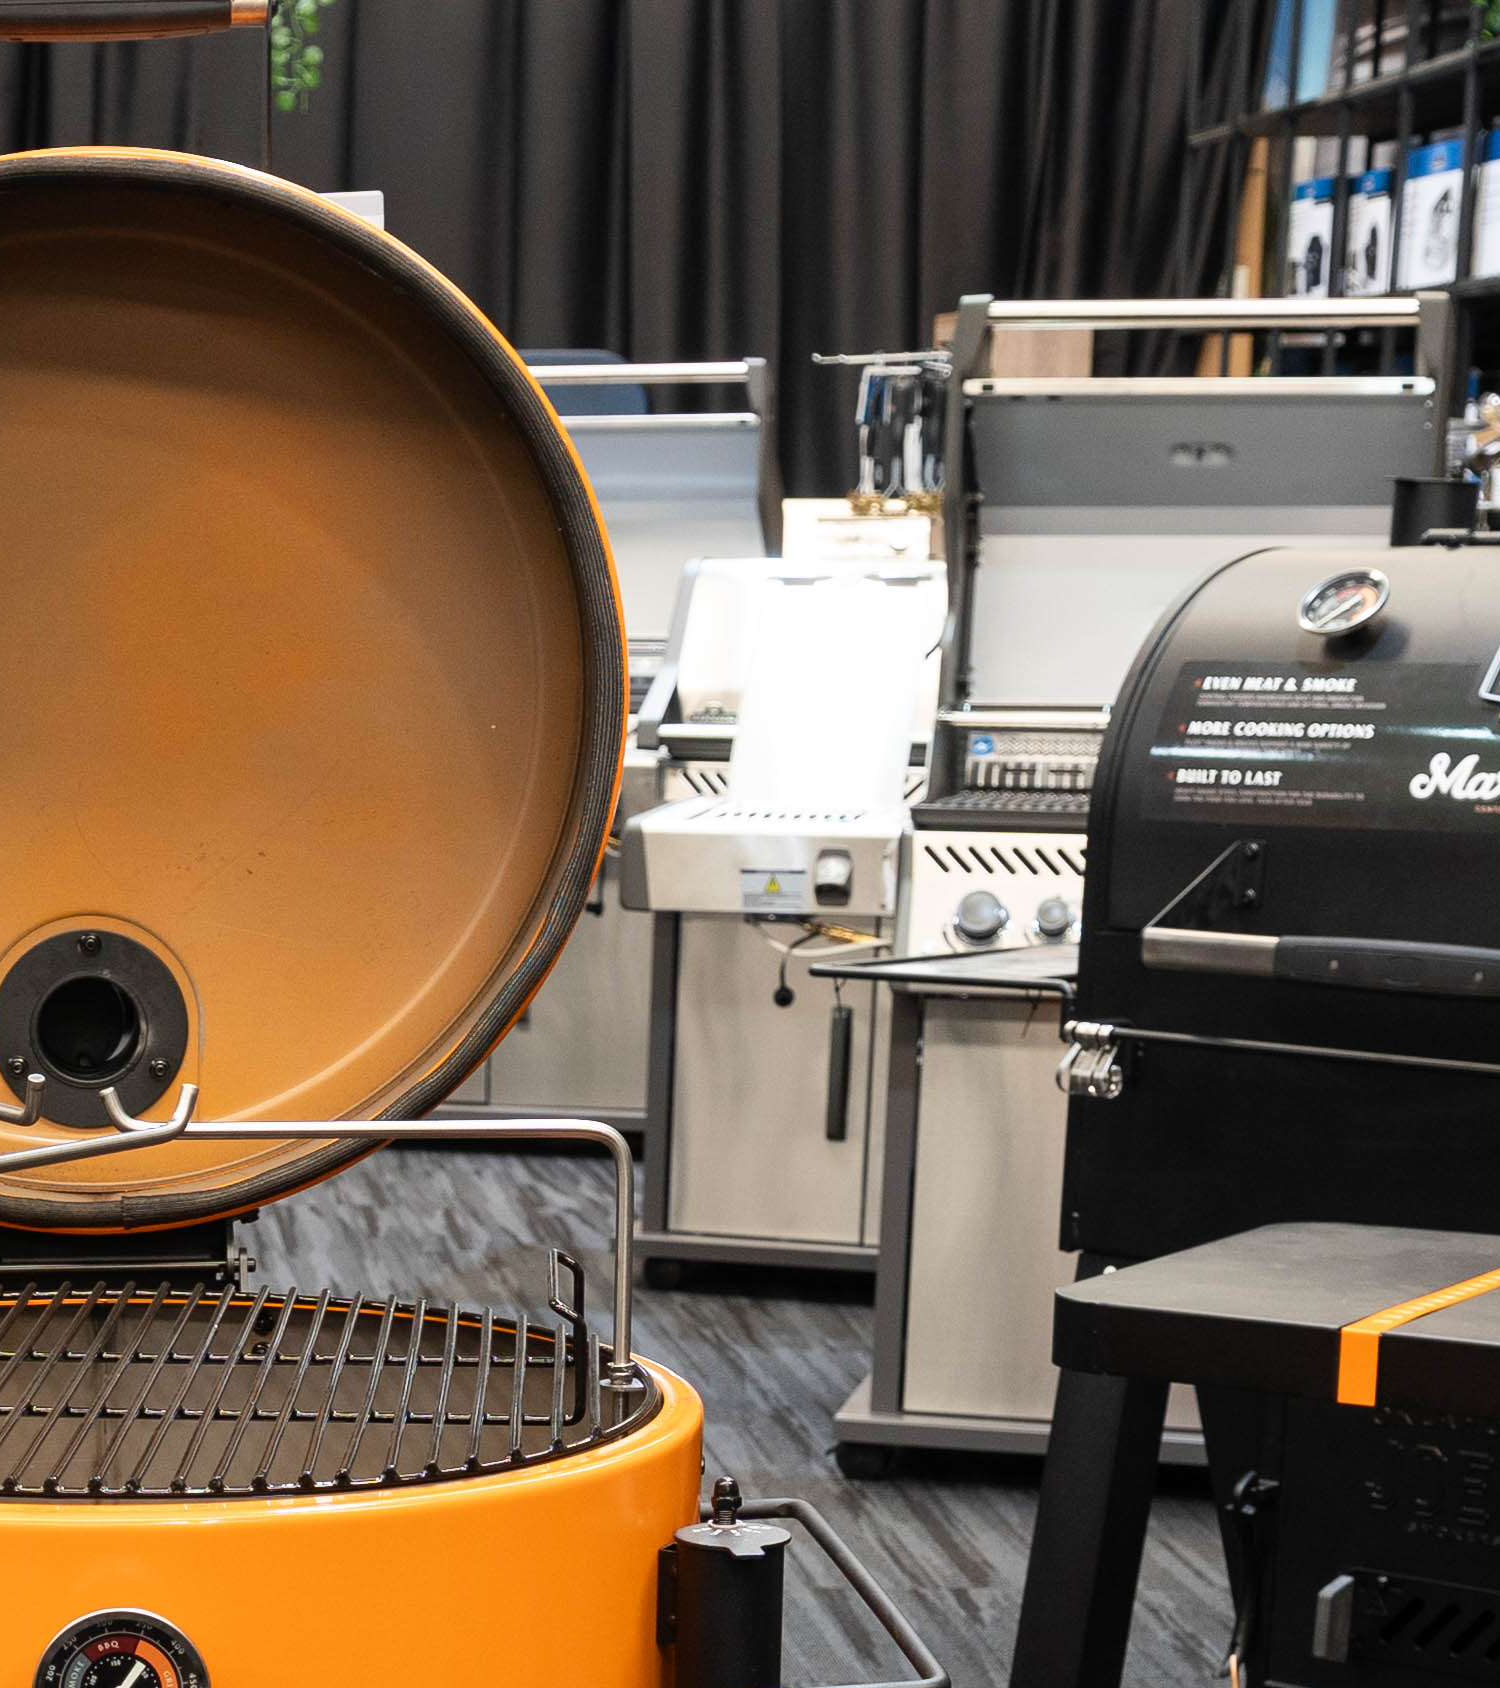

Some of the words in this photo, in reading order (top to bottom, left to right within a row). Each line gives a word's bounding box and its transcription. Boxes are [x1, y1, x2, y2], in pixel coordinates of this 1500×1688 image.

[1202, 676, 1242, 691] EVEN
[1242, 676, 1283, 692] HEAT
[1284, 677, 1297, 692] &
[1301, 677, 1358, 692] SMOKE
[1186, 720, 1232, 737] MORE
[1233, 721, 1305, 738] COOKING
[1306, 723, 1376, 740] OPTIONS
[1175, 768, 1218, 785] BUILT
[1220, 769, 1243, 785] TO
[1244, 770, 1283, 786] LAST
[97, 1640, 120, 1653] BBQ
[45, 1664, 56, 1682] 200
